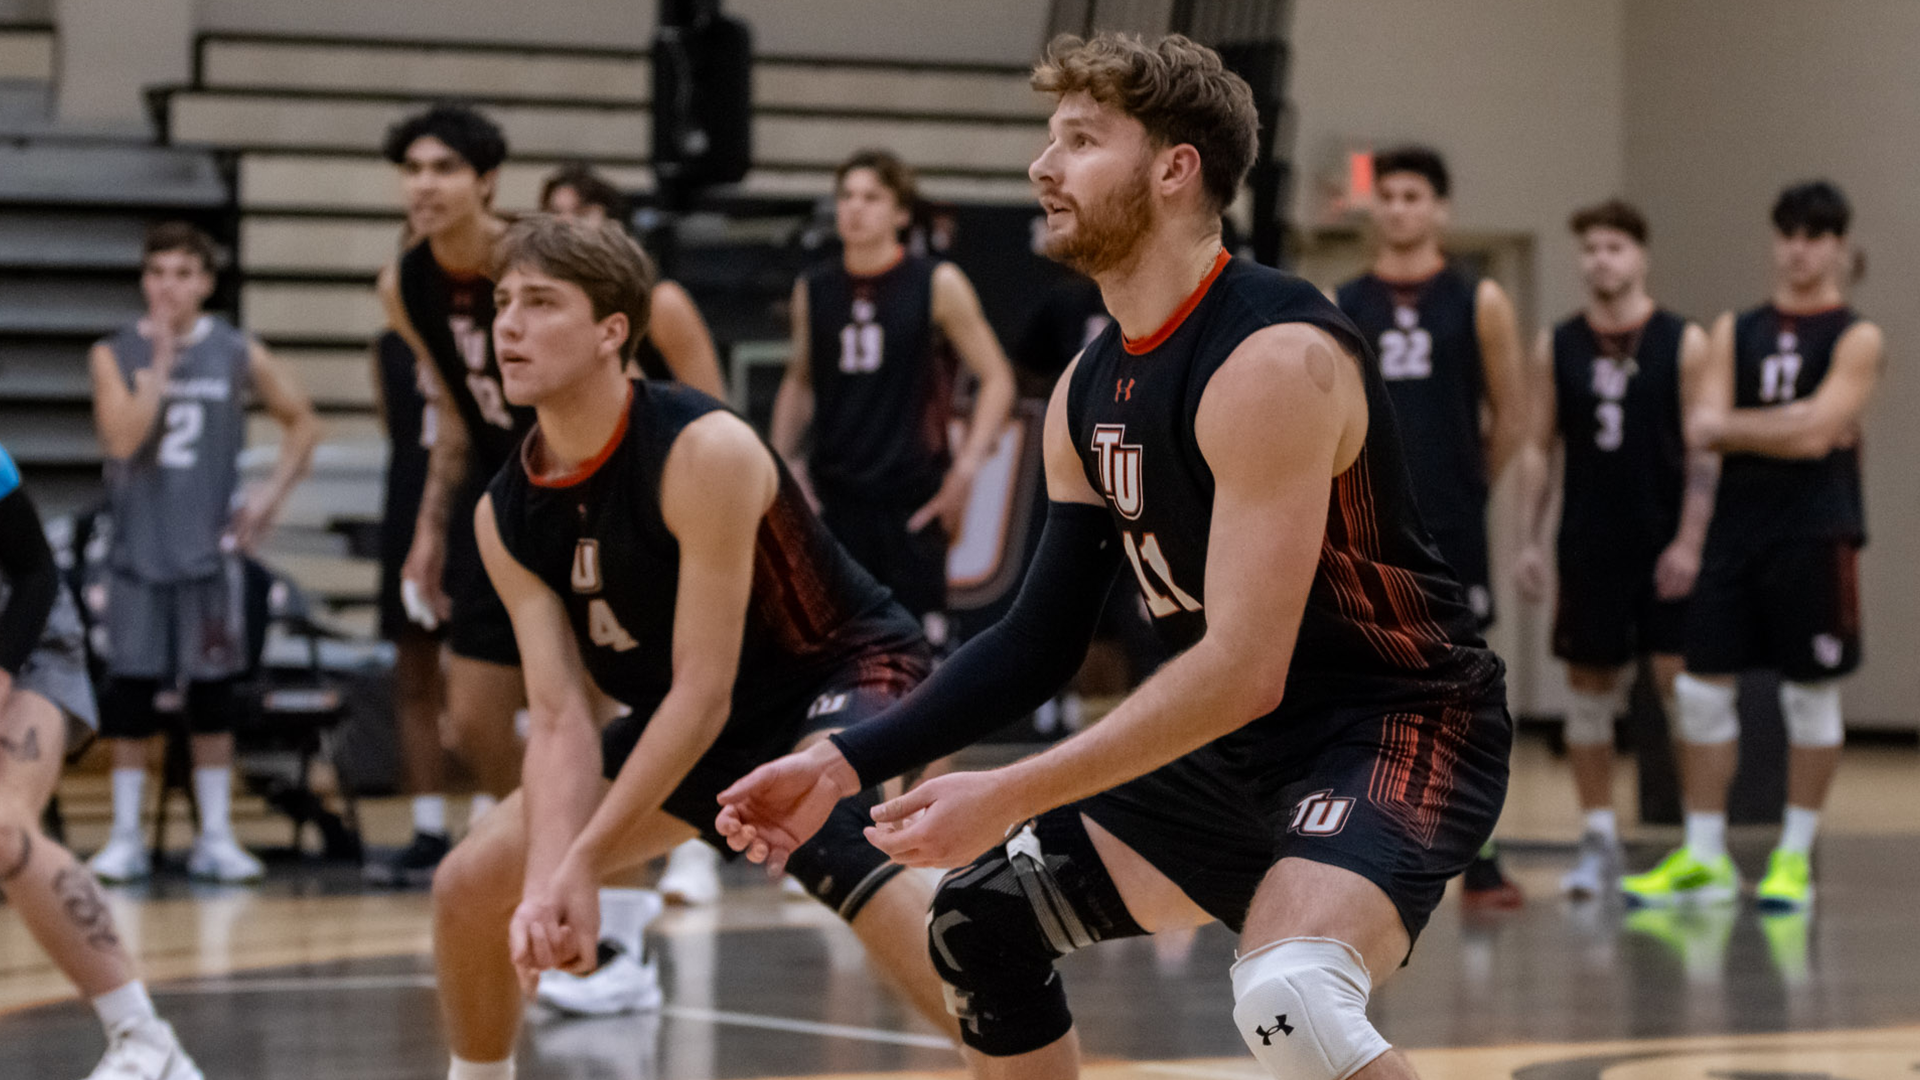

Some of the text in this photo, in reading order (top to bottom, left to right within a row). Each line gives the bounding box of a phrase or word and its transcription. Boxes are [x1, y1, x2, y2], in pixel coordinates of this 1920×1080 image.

[839, 323, 884, 373] 19
[1379, 328, 1432, 379] 22
[161, 402, 204, 467] 2
[1595, 402, 1624, 451] 3
[1091, 423, 1143, 520] TU
[1123, 531, 1203, 618] 11
[589, 599, 639, 652] 4
[1287, 788, 1357, 837] TU
